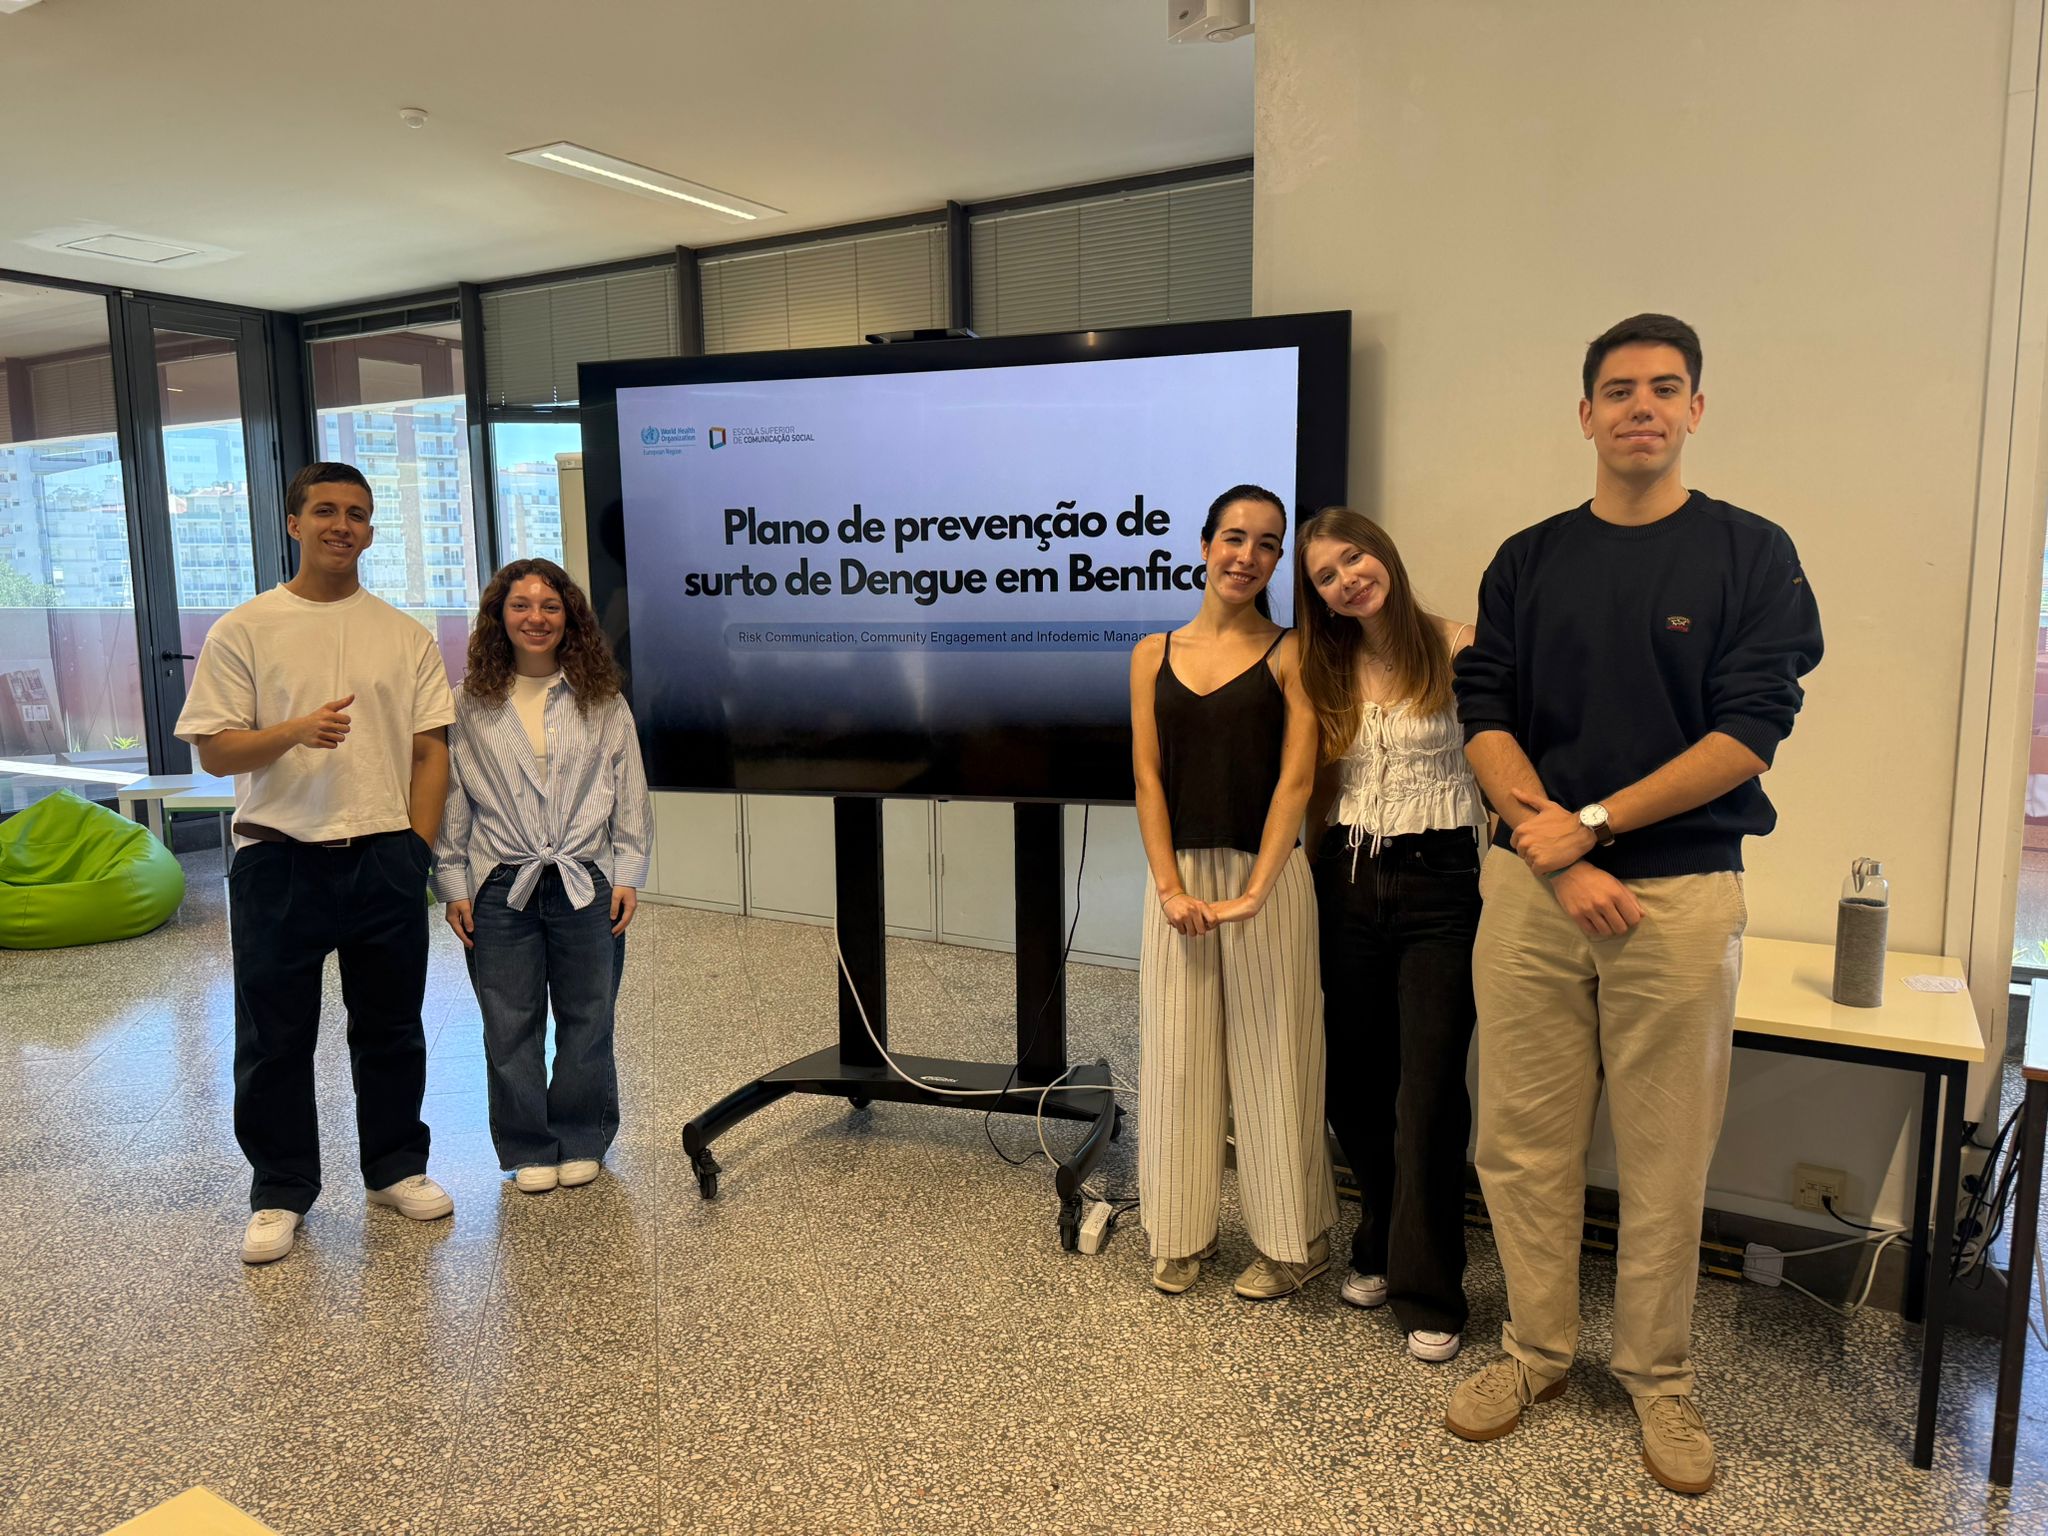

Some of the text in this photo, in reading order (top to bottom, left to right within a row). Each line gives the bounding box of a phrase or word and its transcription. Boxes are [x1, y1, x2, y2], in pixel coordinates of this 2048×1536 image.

[732, 425, 795, 436] ESCOLA SUPERIOR
[661, 435, 696, 443] Organization
[732, 433, 815, 445] DE COMUNICAÇÃO SOCIAL
[724, 494, 1171, 554] Plano de prevenção de
[684, 564, 778, 597] surto
[784, 557, 832, 596] de
[840, 558, 988, 606] Dengue
[995, 568, 1059, 593] em
[738, 631, 762, 643] Risk
[765, 631, 858, 645] Communication,
[860, 631, 927, 645] Community
[930, 631, 1007, 645] Engagement
[1010, 630, 1034, 643] and
[1036, 630, 1101, 643] Infodemic
